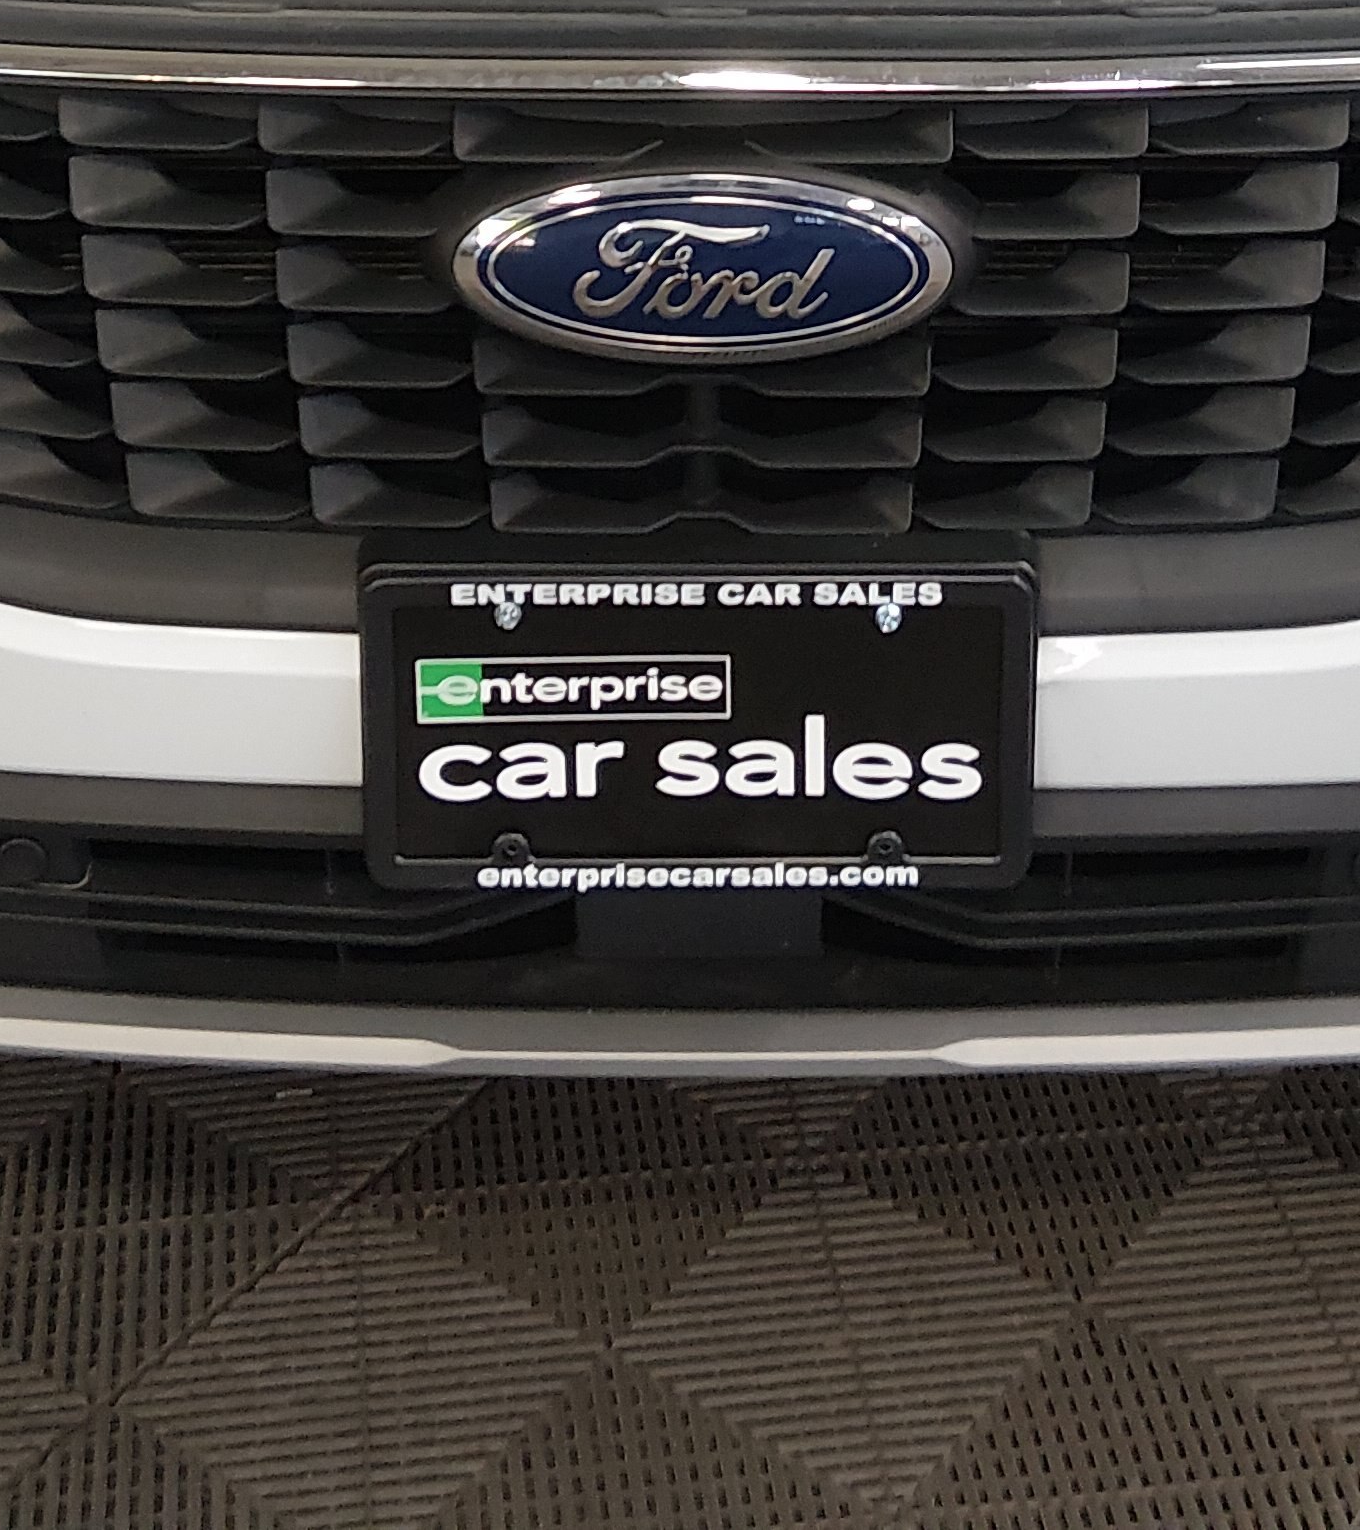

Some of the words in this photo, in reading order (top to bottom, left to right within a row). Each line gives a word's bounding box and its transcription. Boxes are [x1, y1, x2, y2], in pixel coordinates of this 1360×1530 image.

[573, 218, 834, 318] Ford
[451, 582, 705, 606] ENTERPRISE
[717, 583, 801, 606] CAR
[814, 582, 943, 606] SALES
[437, 667, 723, 710] enterprise
[418, 740, 625, 802] car
[655, 714, 982, 800] sales
[478, 864, 919, 891] enterprisecarsales.com
